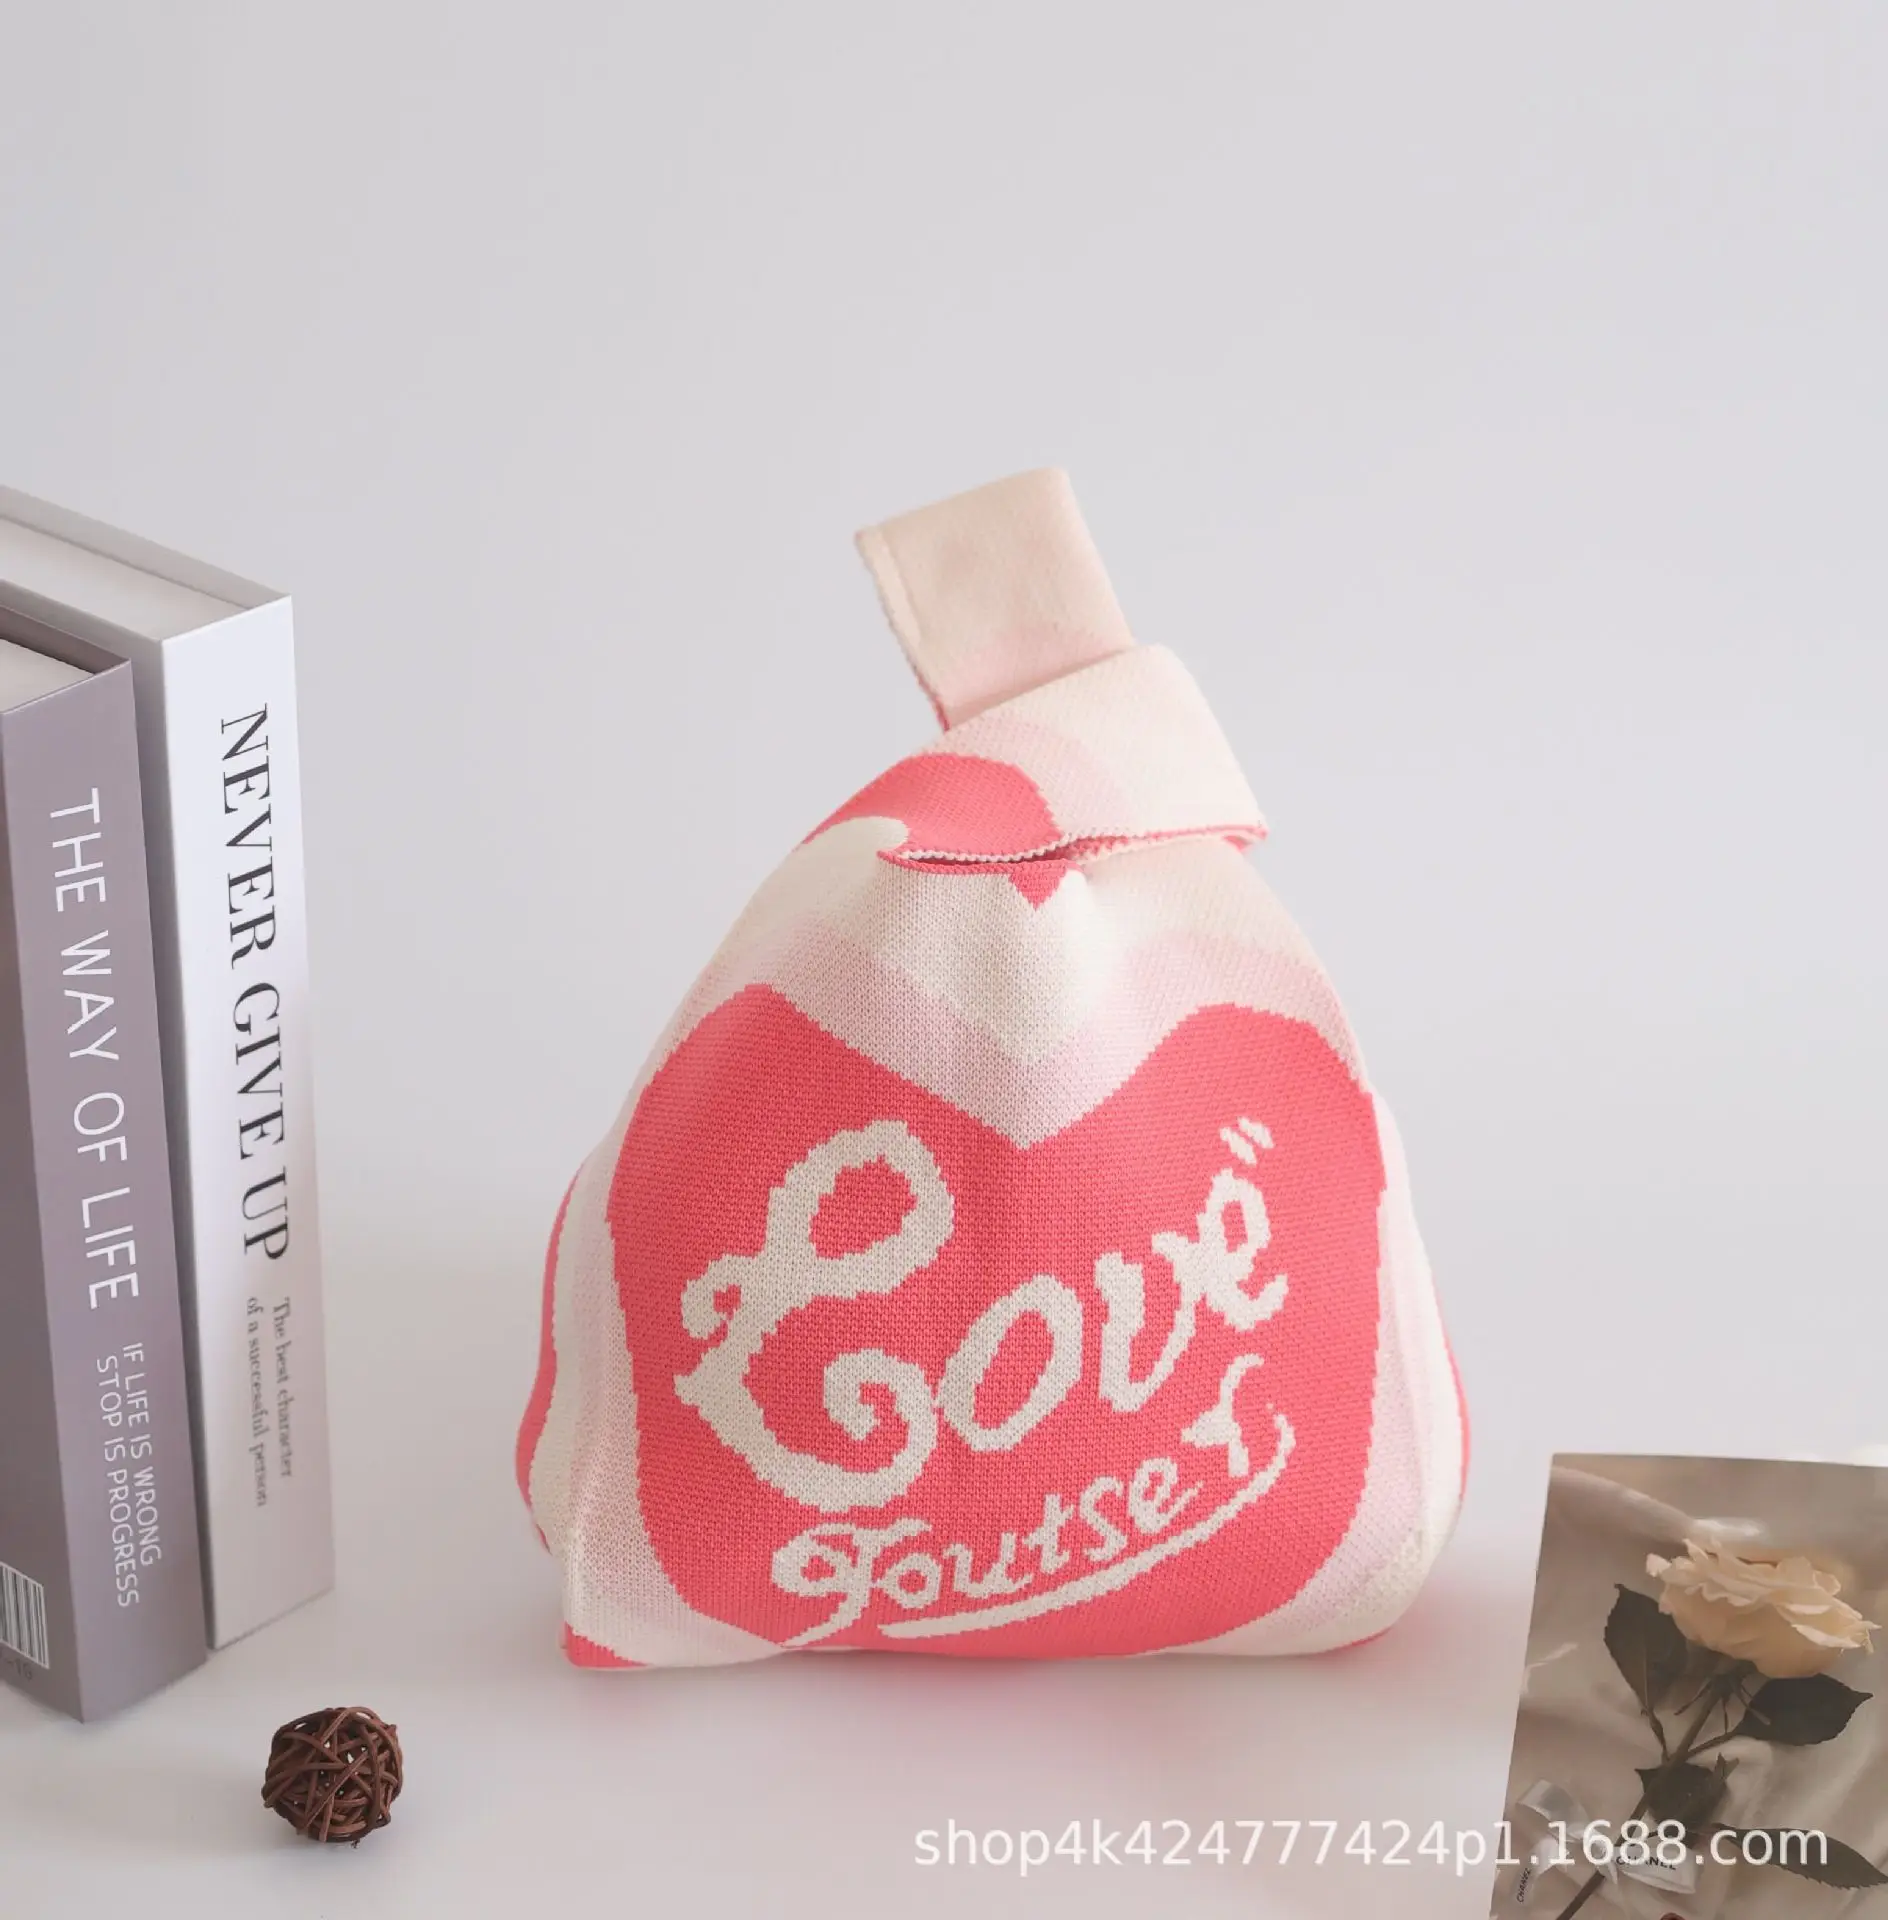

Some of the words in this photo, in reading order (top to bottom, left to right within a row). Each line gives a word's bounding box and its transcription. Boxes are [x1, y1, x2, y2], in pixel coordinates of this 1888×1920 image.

[50, 787, 106, 912] THE
[221, 702, 277, 970] NEVER
[60, 929, 119, 1062] WAY
[232, 982, 285, 1161] GIVE
[73, 1090, 128, 1162] OF
[82, 1187, 139, 1310] LIFE
[242, 1166, 290, 1261] UP
[247, 1297, 264, 1316] of
[248, 1320, 259, 1335] a
[273, 1296, 291, 1338] The
[674, 1119, 1289, 1513] Love
[97, 1355, 123, 1428] STOP
[123, 1342, 144, 1363] IF
[248, 1338, 271, 1438] successful
[275, 1340, 292, 1385] best
[125, 1372, 150, 1428] LIFE
[276, 1388, 295, 1478] character
[104, 1436, 126, 1462] IS
[130, 1433, 153, 1459] IS
[249, 1442, 267, 1507] person
[107, 1468, 140, 1608] PROGRESS
[133, 1465, 163, 1567] WRONG
